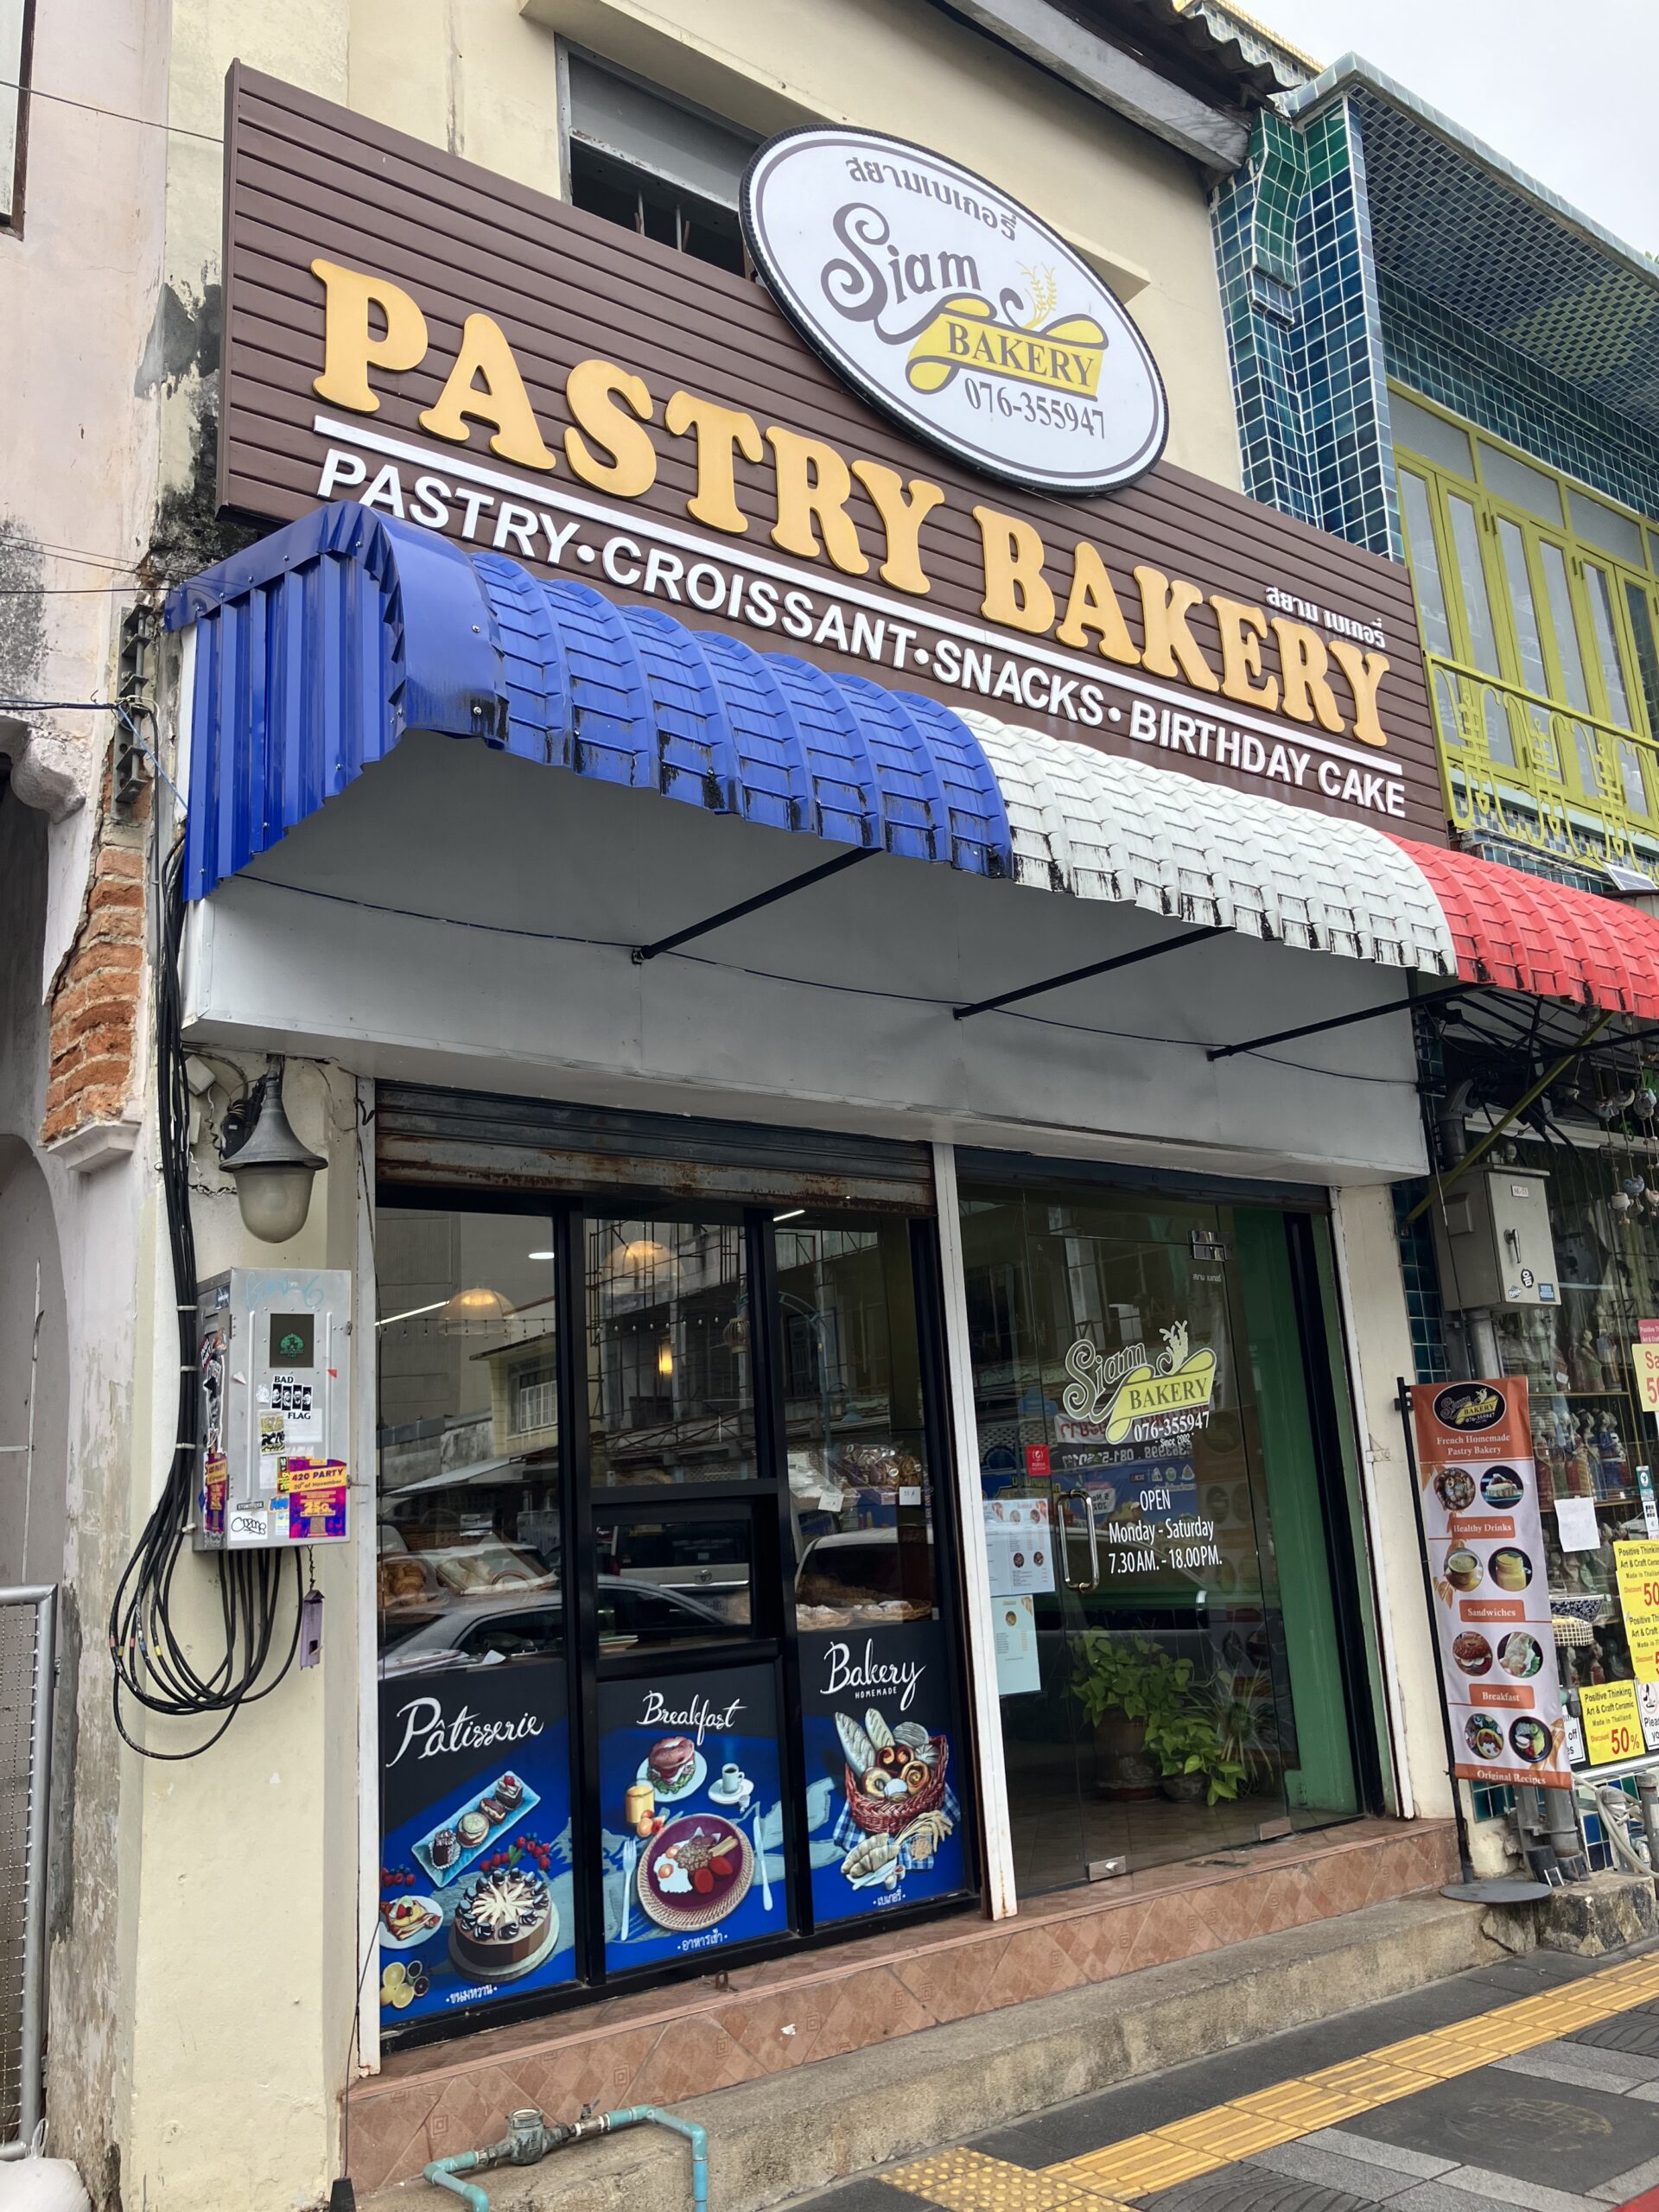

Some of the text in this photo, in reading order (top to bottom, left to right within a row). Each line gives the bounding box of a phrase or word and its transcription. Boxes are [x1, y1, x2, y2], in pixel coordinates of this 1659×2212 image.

[821, 202, 982, 322] Siam
[947, 321, 1095, 388] BAKERY
[964, 378, 1106, 438] 076-355947
[310, 258, 1390, 747] PASTRY BAKERY
[1266, 587, 1385, 648] สยาม เบเกอรี่
[316, 448, 1406, 817] PASTRY CROISSANT SNACKS BIRTHDAY CAKE
[1063, 1339, 1148, 1421] Siam
[1646, 1377, 1659, 1404] 5
[1129, 1377, 1208, 1411] BAKERY
[1464, 1403, 1495, 1415] BAKERY
[1134, 1411, 1210, 1442] 076-355947
[1160, 1438, 1175, 1447] Since
[1176, 1434, 1191, 1444] 2002
[1437, 1433, 1510, 1446] French Homemade
[1447, 1446, 1502, 1456] Pastry Bakery
[313, 1468, 343, 1479] PARTY
[1140, 1489, 1171, 1511] OPEN
[1109, 1519, 1155, 1545] Monday
[1165, 1516, 1214, 1541] Saturday
[1453, 1523, 1512, 1533] Healthy Drinks
[1467, 1608, 1516, 1617] Sandwiches
[1630, 1617, 1650, 1625] Positive
[820, 1638, 926, 1711] Bakery
[855, 1686, 898, 1699] HOMEMADE
[1482, 1692, 1521, 1702] Breakfast
[1585, 1688, 1631, 1702] Positive Thinking
[636, 1690, 748, 1745] Breakfast
[1601, 1703, 1615, 1713] Craft
[1615, 1701, 1635, 1711] Ceramic
[385, 1697, 545, 1767] Pâtisserie
[1568, 1728, 1578, 1740] off
[1477, 1770, 1546, 1785] Original Recipes
[682, 1929, 724, 1952] อาหารเช้า
[449, 1985, 493, 2005] ขนมหวาน
